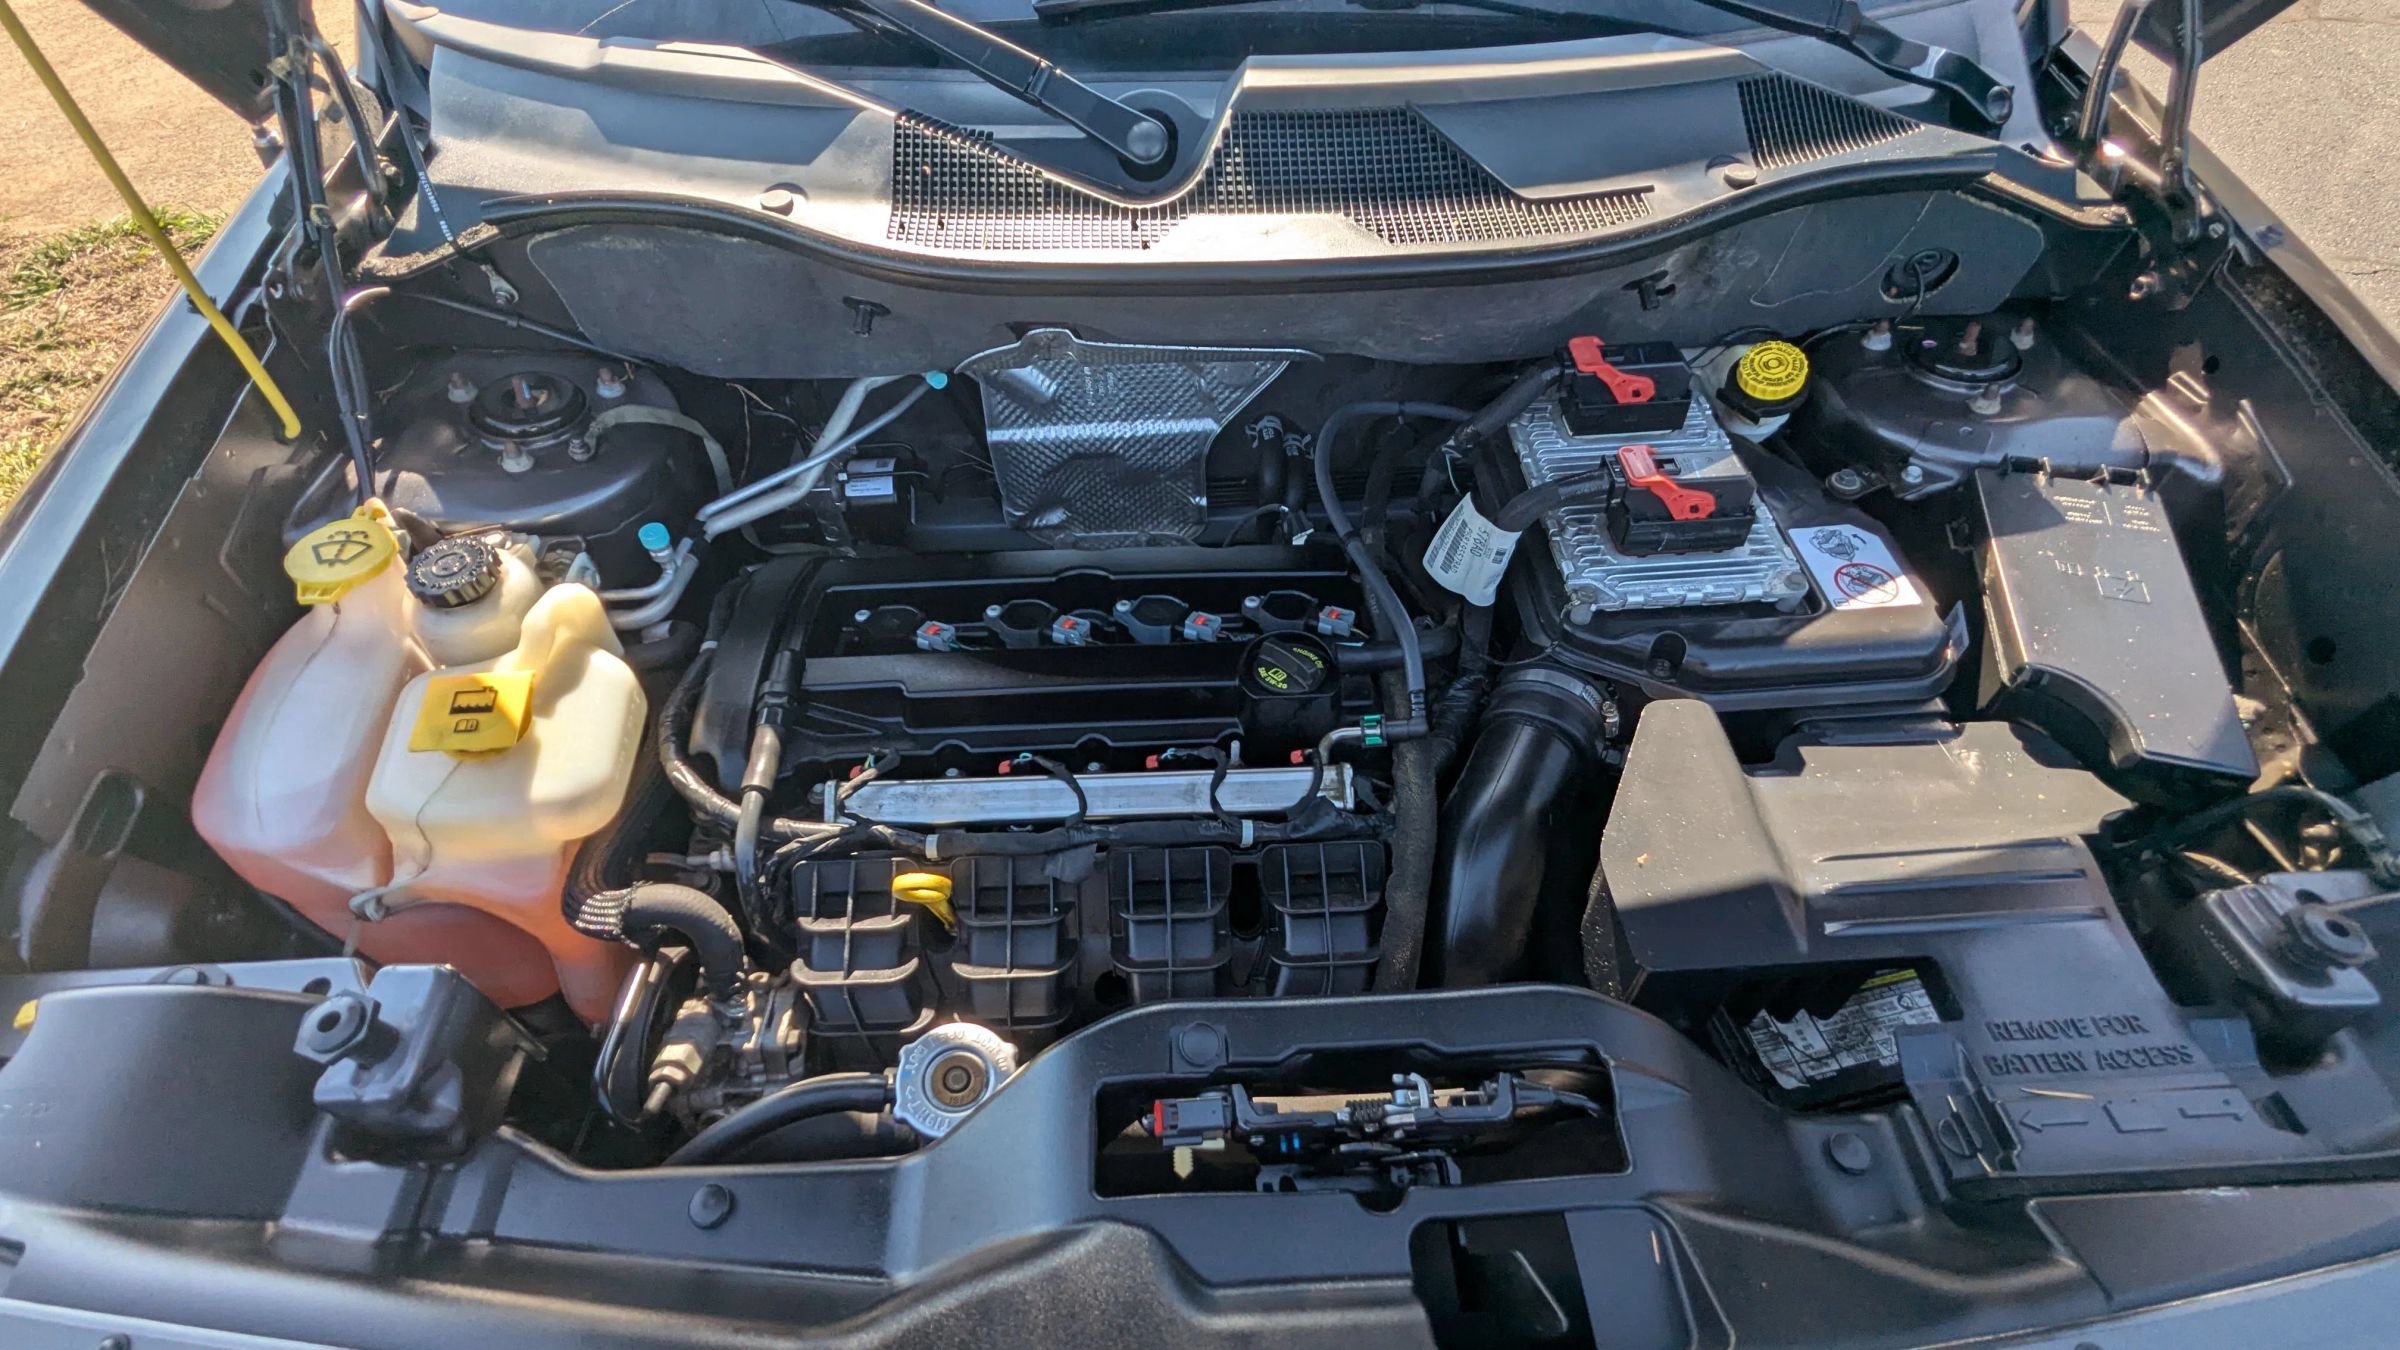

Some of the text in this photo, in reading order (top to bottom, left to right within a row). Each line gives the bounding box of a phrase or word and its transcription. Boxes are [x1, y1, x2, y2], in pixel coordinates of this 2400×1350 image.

[1985, 1014, 2150, 1042] REMOVE FOR
[1982, 1044, 2195, 1076] BATTERY ACCESS
